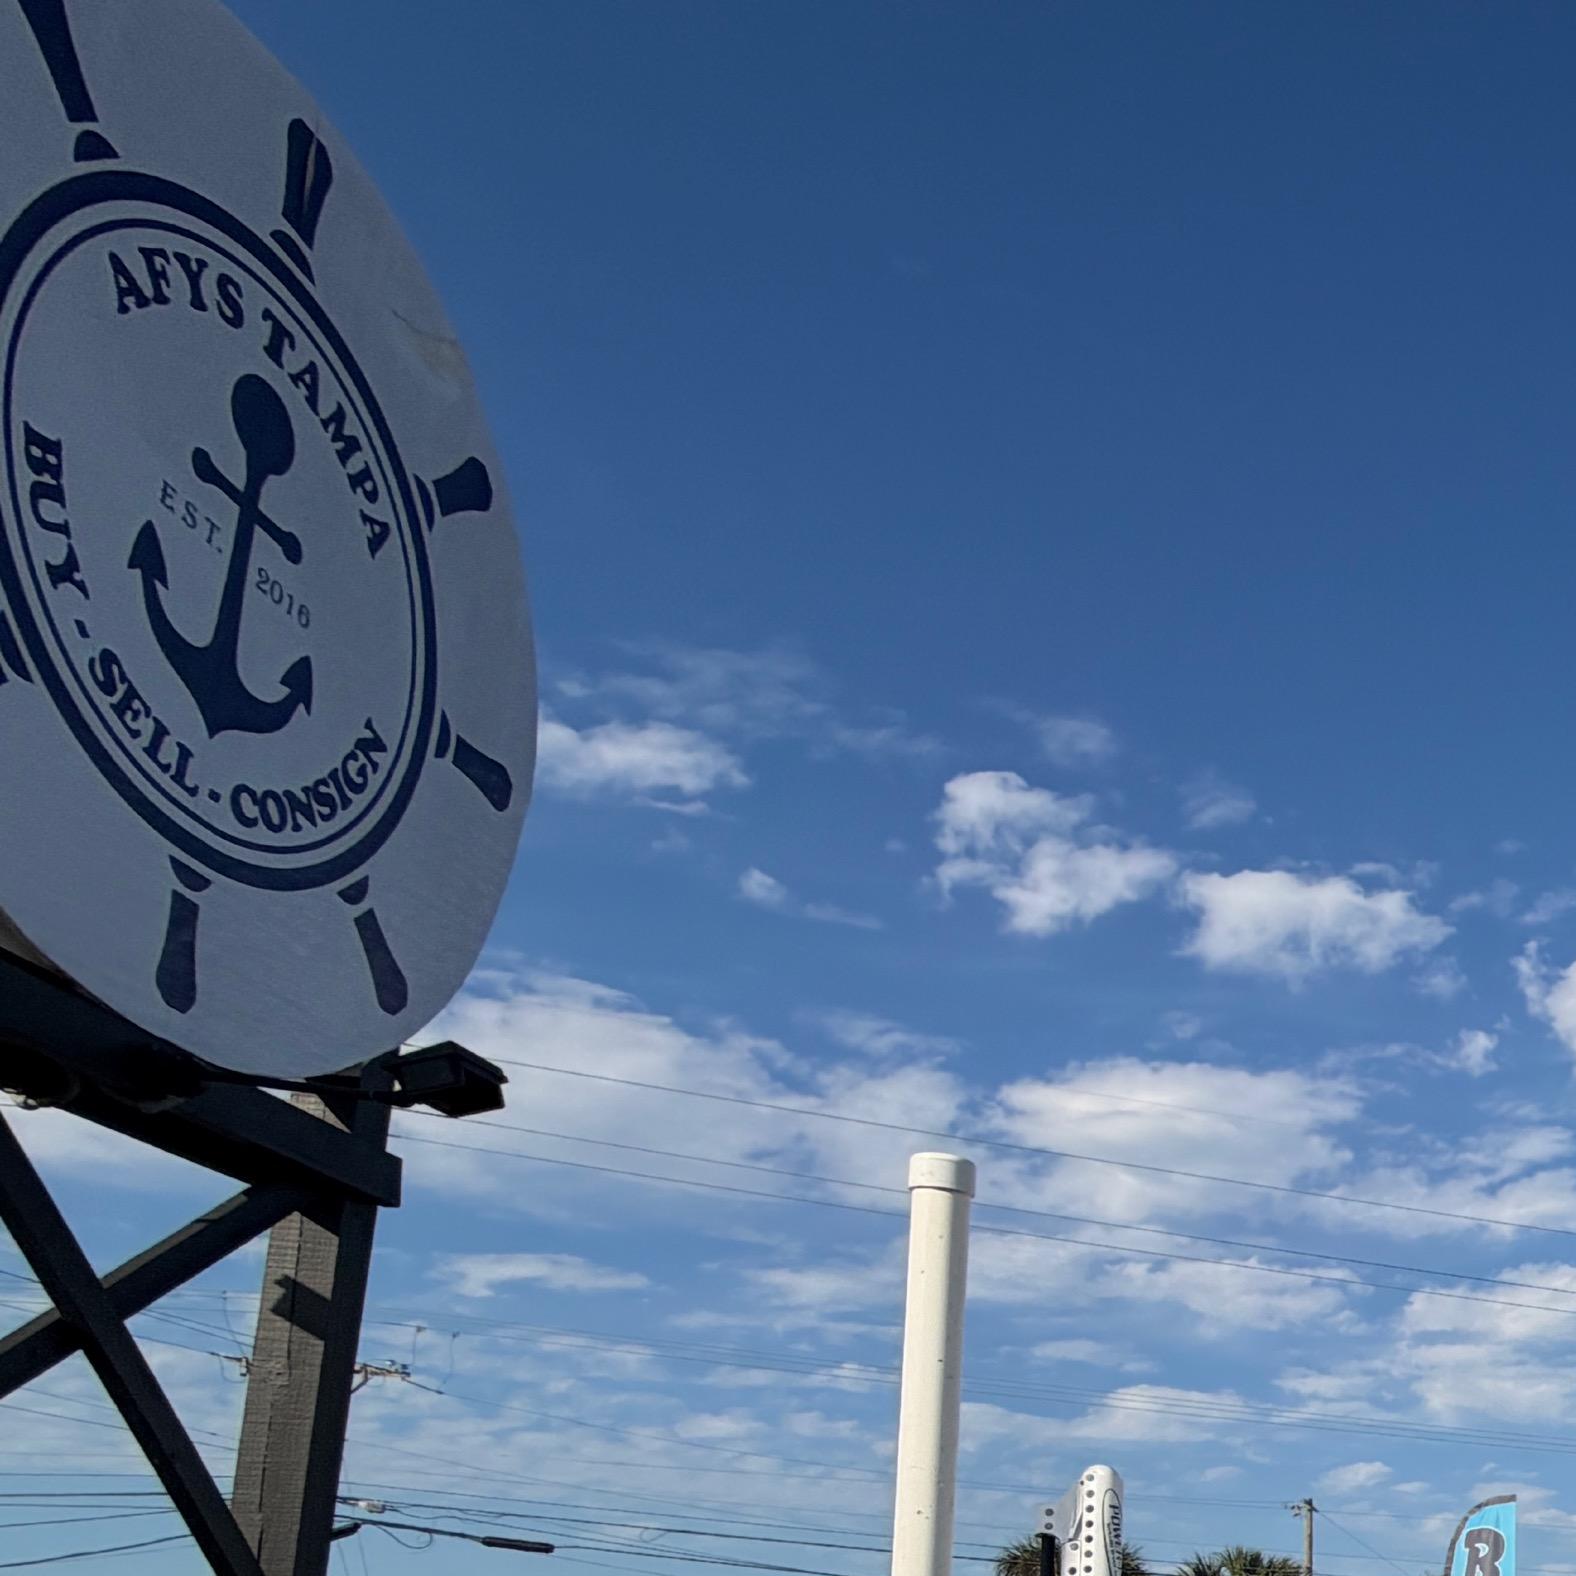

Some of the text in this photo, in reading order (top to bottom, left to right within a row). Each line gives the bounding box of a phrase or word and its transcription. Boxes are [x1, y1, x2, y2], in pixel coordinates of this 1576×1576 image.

[108, 246, 390, 560] AFYS TAMPA
[159, 478, 223, 554] EST.
[22, 420, 90, 600] BUY
[88, 648, 200, 798] SELL
[230, 717, 388, 832] CONSIGN
